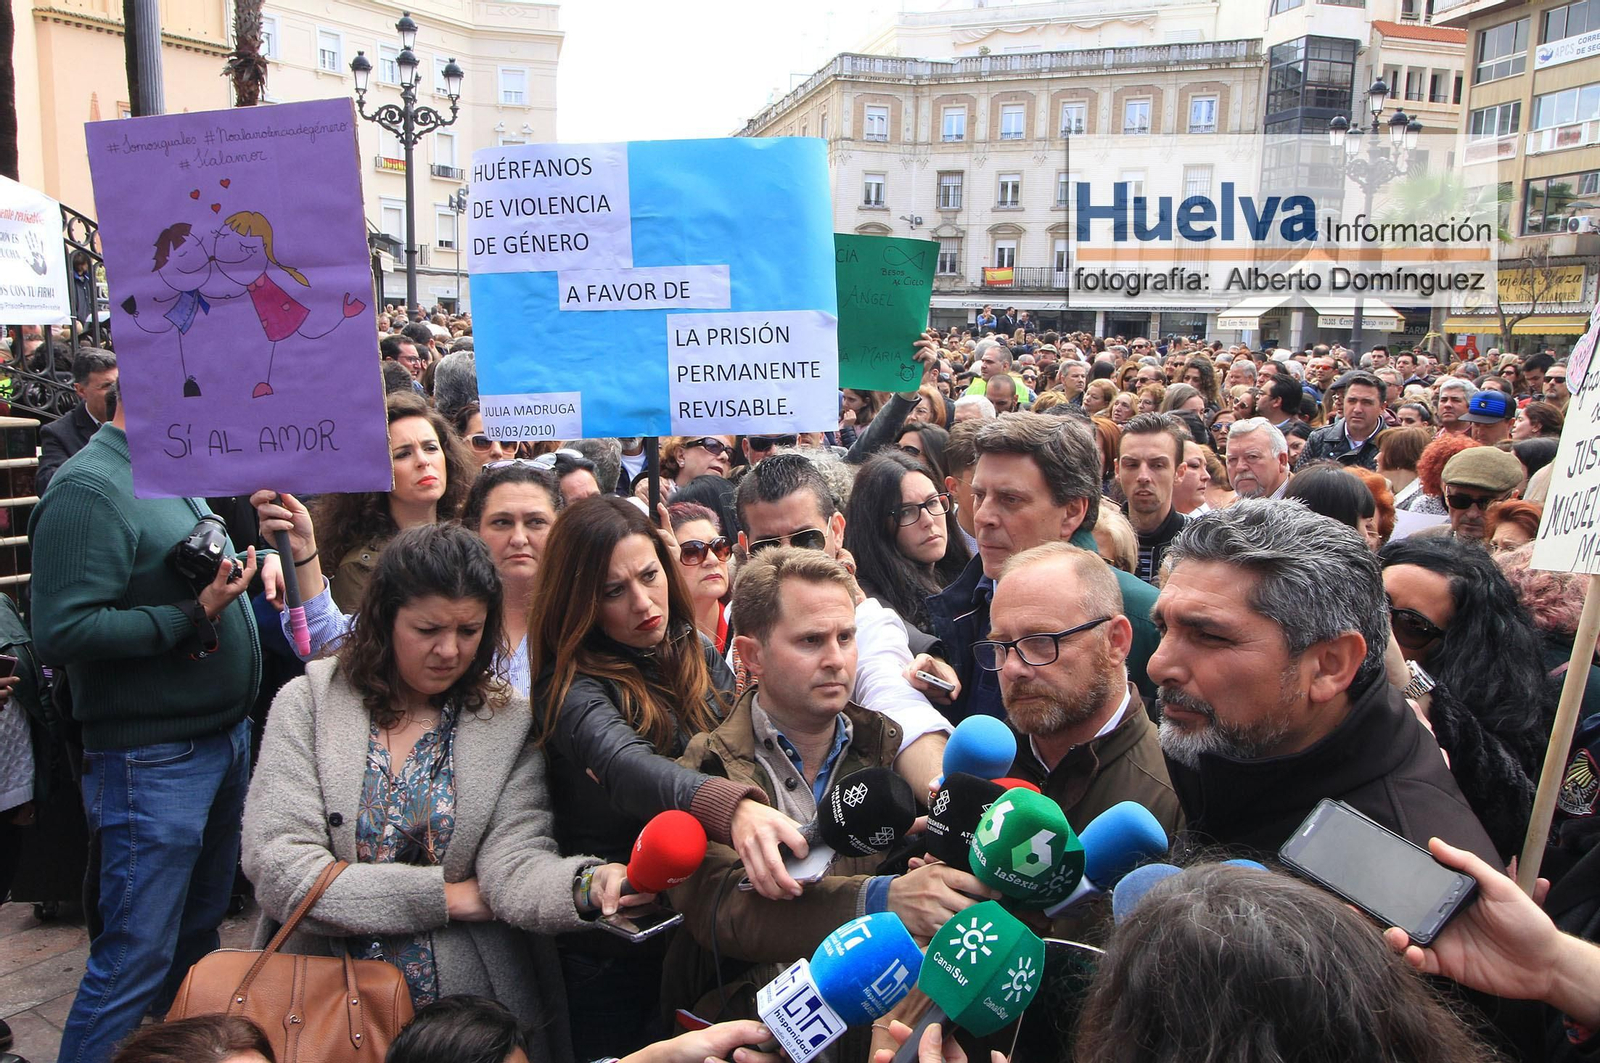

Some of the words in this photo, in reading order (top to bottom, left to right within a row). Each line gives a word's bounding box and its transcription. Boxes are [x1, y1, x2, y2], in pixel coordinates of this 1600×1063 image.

[473, 156, 593, 182] HUÉRFANOS
[472, 200, 494, 219] DE
[499, 194, 612, 217] VIOLENCIA
[473, 236, 497, 256] DE
[503, 230, 590, 254] GÉNERO
[880, 268, 906, 277] BESOS
[903, 276, 924, 287] CIELO
[565, 285, 582, 304] A
[586, 282, 657, 303] FAVOR
[664, 280, 692, 301] DE
[675, 327, 700, 347] LA
[707, 321, 791, 346] PRISIÓN
[676, 359, 822, 384] PERMANENTE
[483, 403, 511, 418] JULIA
[513, 401, 577, 417] MADRUGA
[678, 396, 795, 420] REVISABLE.
[208, 428, 243, 455] AL
[257, 418, 341, 455] AMOR
[485, 422, 557, 440] (18/03/2010)
[993, 866, 1039, 891] laSexta
[933, 951, 969, 987] CanalSur
[983, 996, 1009, 1021] CanalSur
[773, 1008, 812, 1056] hispanidad
